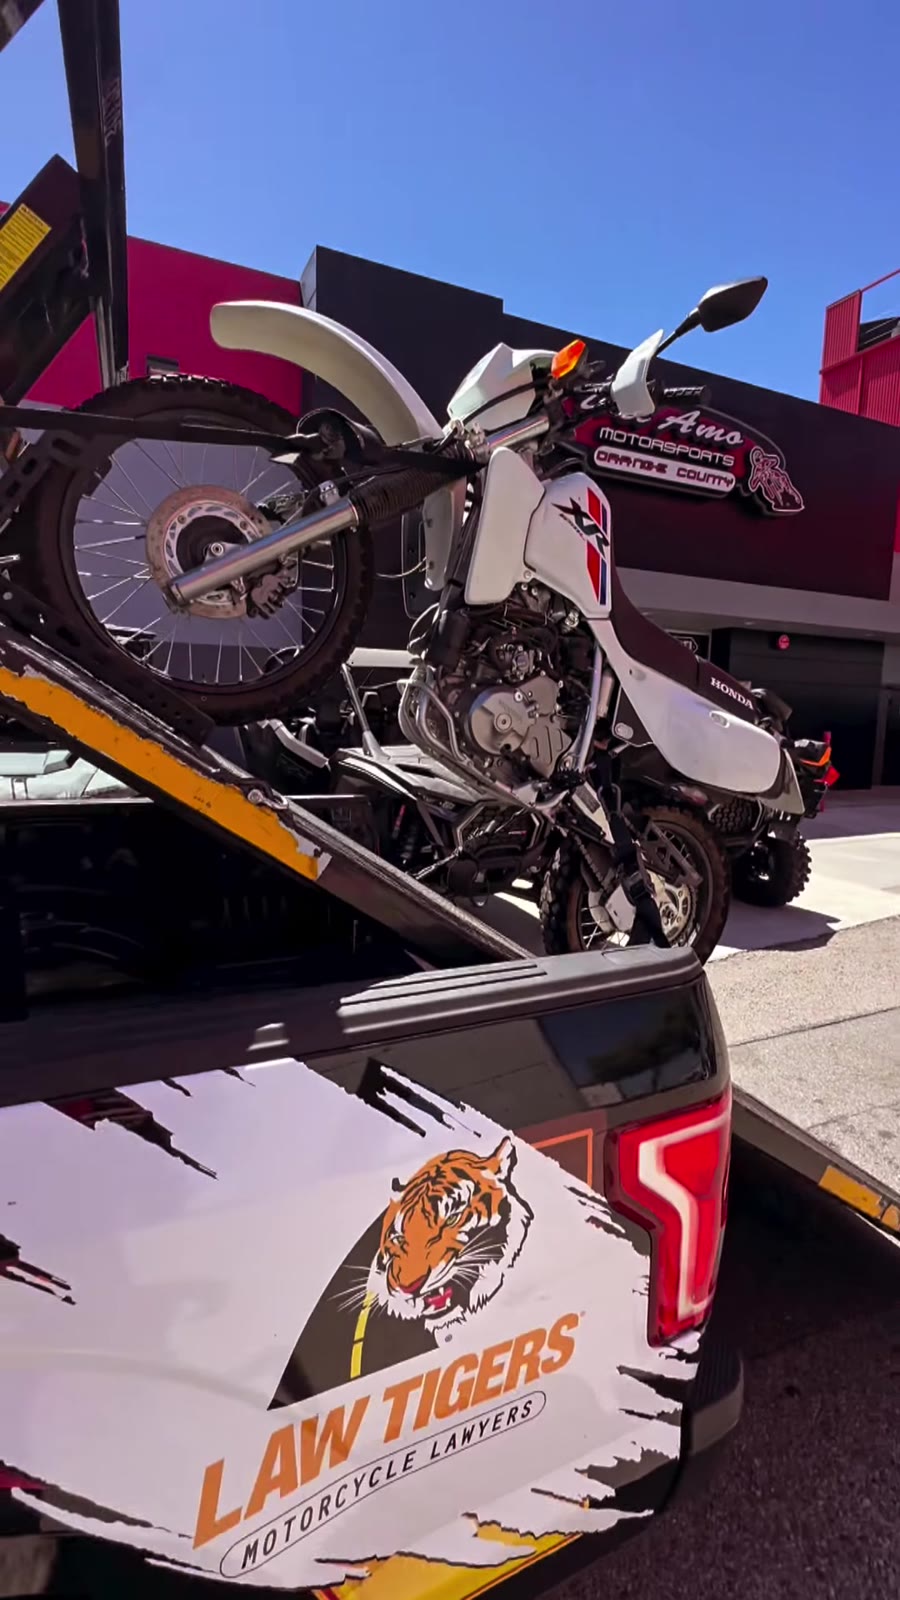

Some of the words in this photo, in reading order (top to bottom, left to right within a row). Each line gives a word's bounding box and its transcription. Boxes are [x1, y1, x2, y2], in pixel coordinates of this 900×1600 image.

[599, 425, 736, 467] MOTORSPORTS
[657, 410, 744, 446] Amo
[596, 450, 668, 475] ORANGE
[675, 466, 735, 489] COUNTY
[710, 676, 755, 711] HONDA
[192, 1394, 372, 1550] LAW
[382, 1311, 582, 1445] TIGERS
[240, 1450, 417, 1571] MOTORCYCLE
[429, 1399, 534, 1460] LAWYERS
